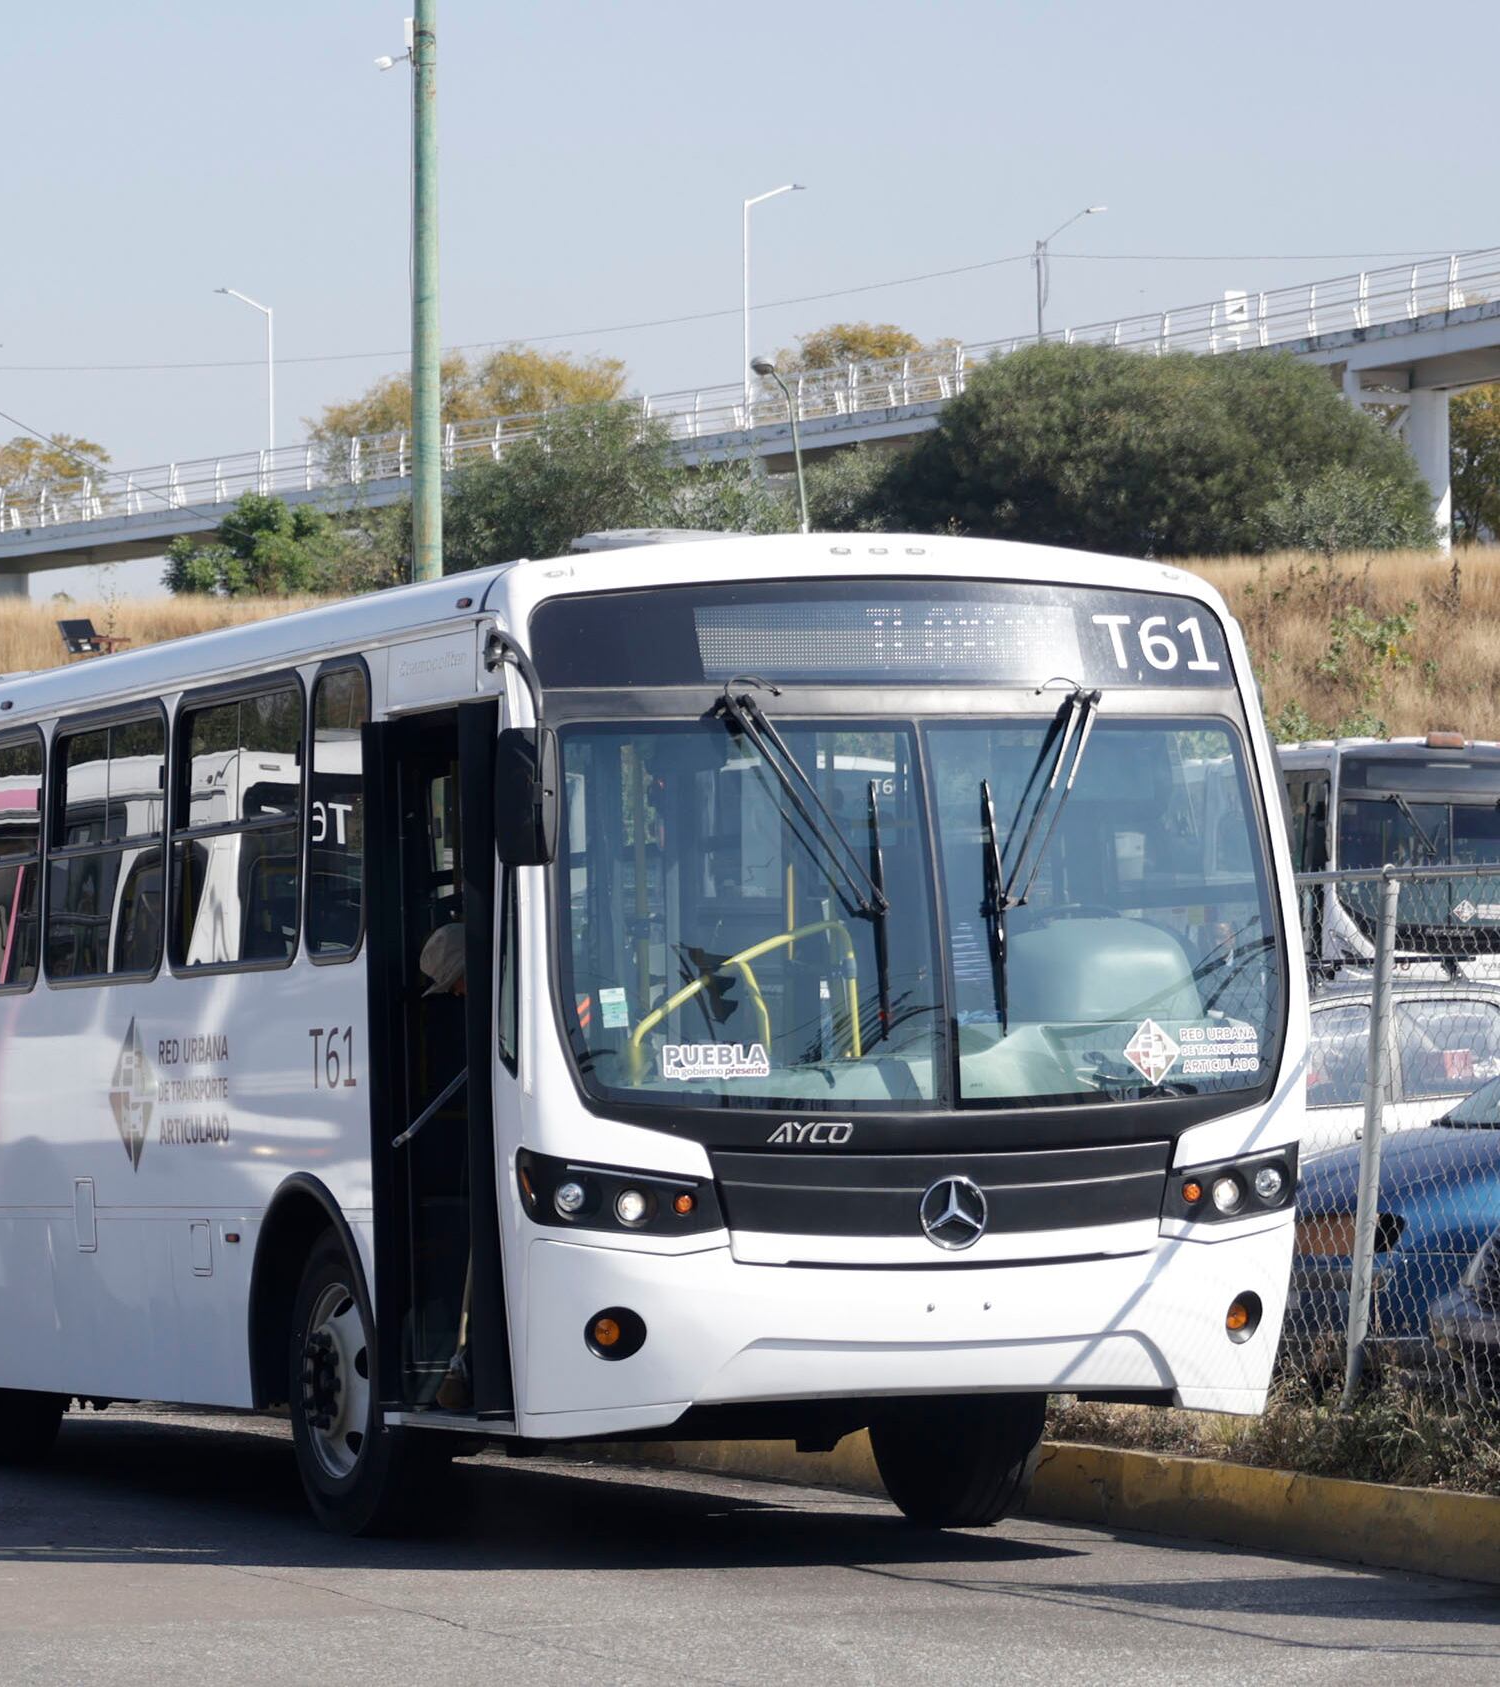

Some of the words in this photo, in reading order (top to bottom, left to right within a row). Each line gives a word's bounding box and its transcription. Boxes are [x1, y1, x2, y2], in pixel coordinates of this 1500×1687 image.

[1091, 614, 1220, 672] T61
[871, 778, 897, 796] T6
[1180, 1028, 1204, 1041] RED
[1207, 1027, 1257, 1039] URBANA
[158, 1039, 180, 1065] RED
[183, 1035, 229, 1063] URBANA
[309, 1026, 357, 1089] T61
[665, 1046, 767, 1066] PUEBLA
[1181, 1045, 1194, 1055] DE
[1195, 1044, 1258, 1055] TRANSPORTE
[666, 1067, 680, 1076] Un
[681, 1066, 724, 1078] gobierno
[724, 1066, 768, 1078] presente
[1183, 1058, 1259, 1072] ARTICULADO
[158, 1081, 169, 1102] DE
[170, 1078, 228, 1101] TRANSPORTE
[159, 1117, 230, 1145] ARTICULADO
[766, 1121, 854, 1144] AYCO
